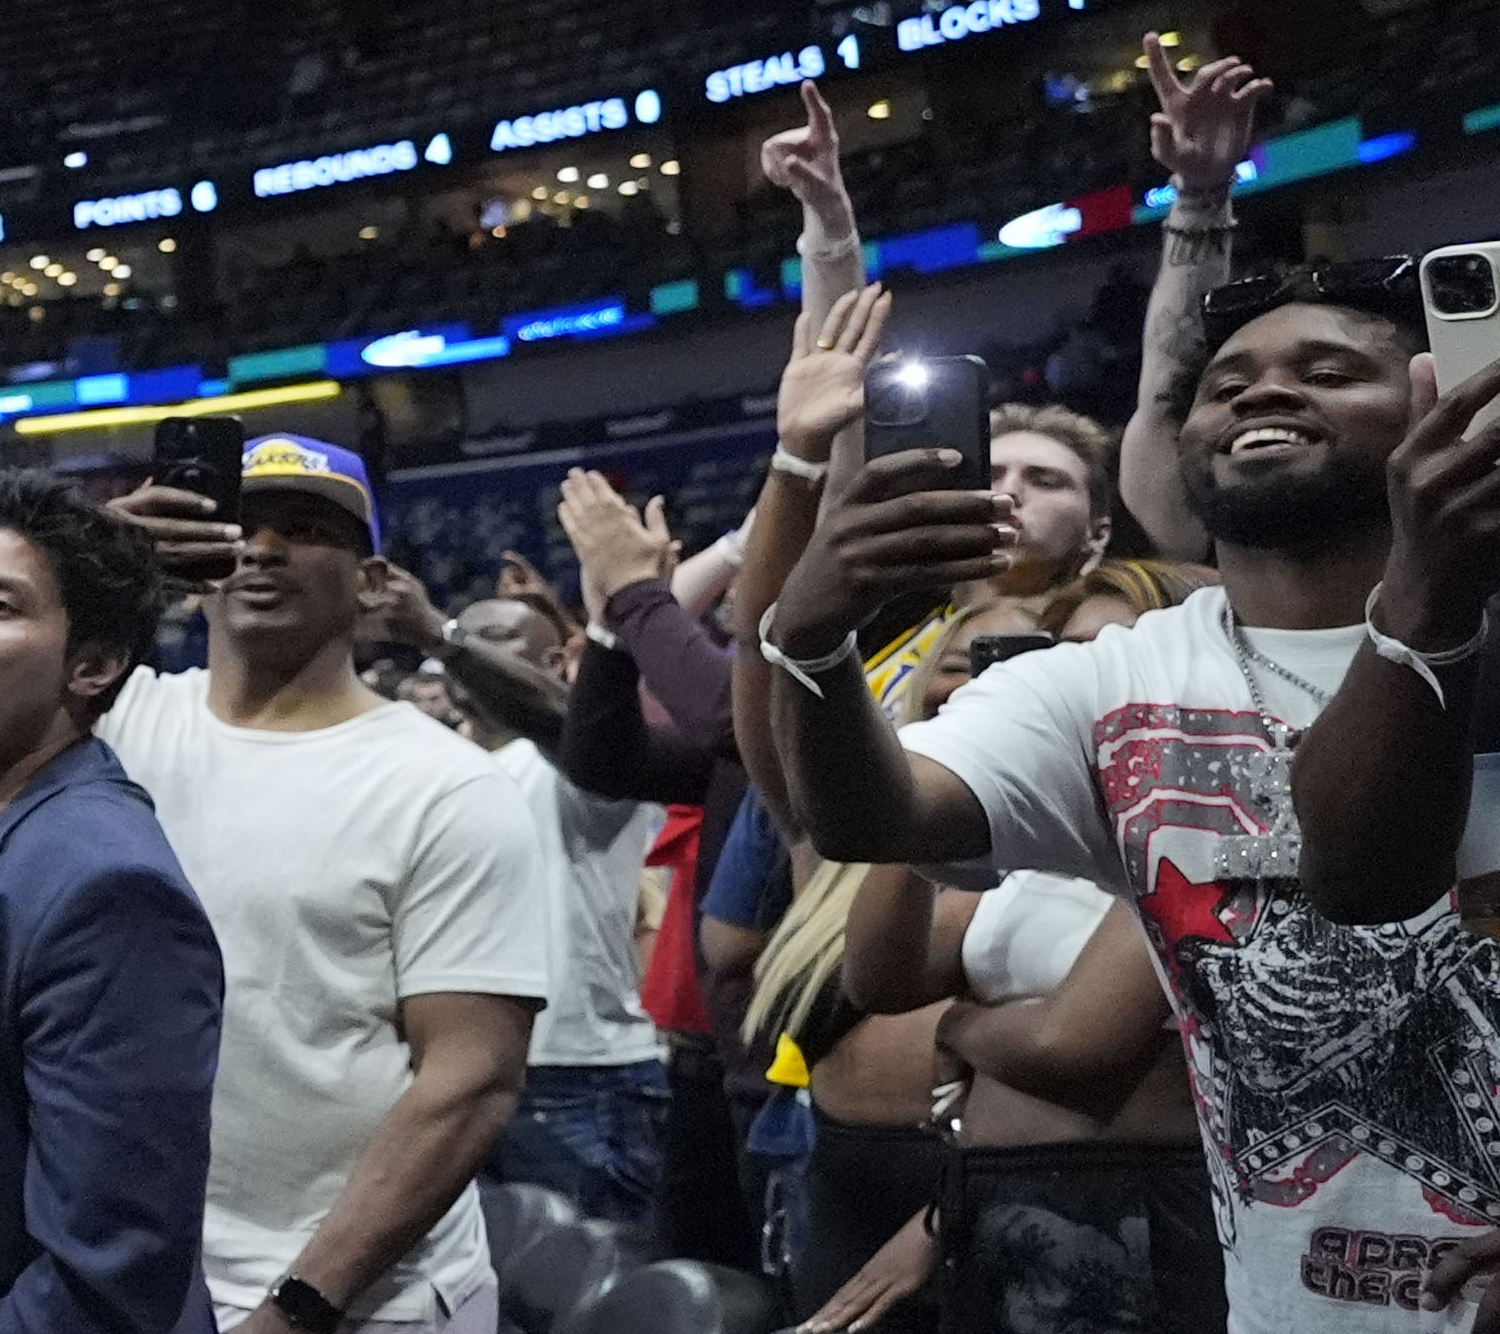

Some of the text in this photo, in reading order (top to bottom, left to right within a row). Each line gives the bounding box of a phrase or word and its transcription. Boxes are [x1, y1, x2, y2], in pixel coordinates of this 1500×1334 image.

[704, 43, 827, 104] STEALS
[836, 33, 861, 70] 1
[73, 185, 183, 230] POINTS
[253, 138, 419, 198] REBOUNDS
[424, 131, 454, 166] 4
[489, 96, 629, 152] ASSISTS
